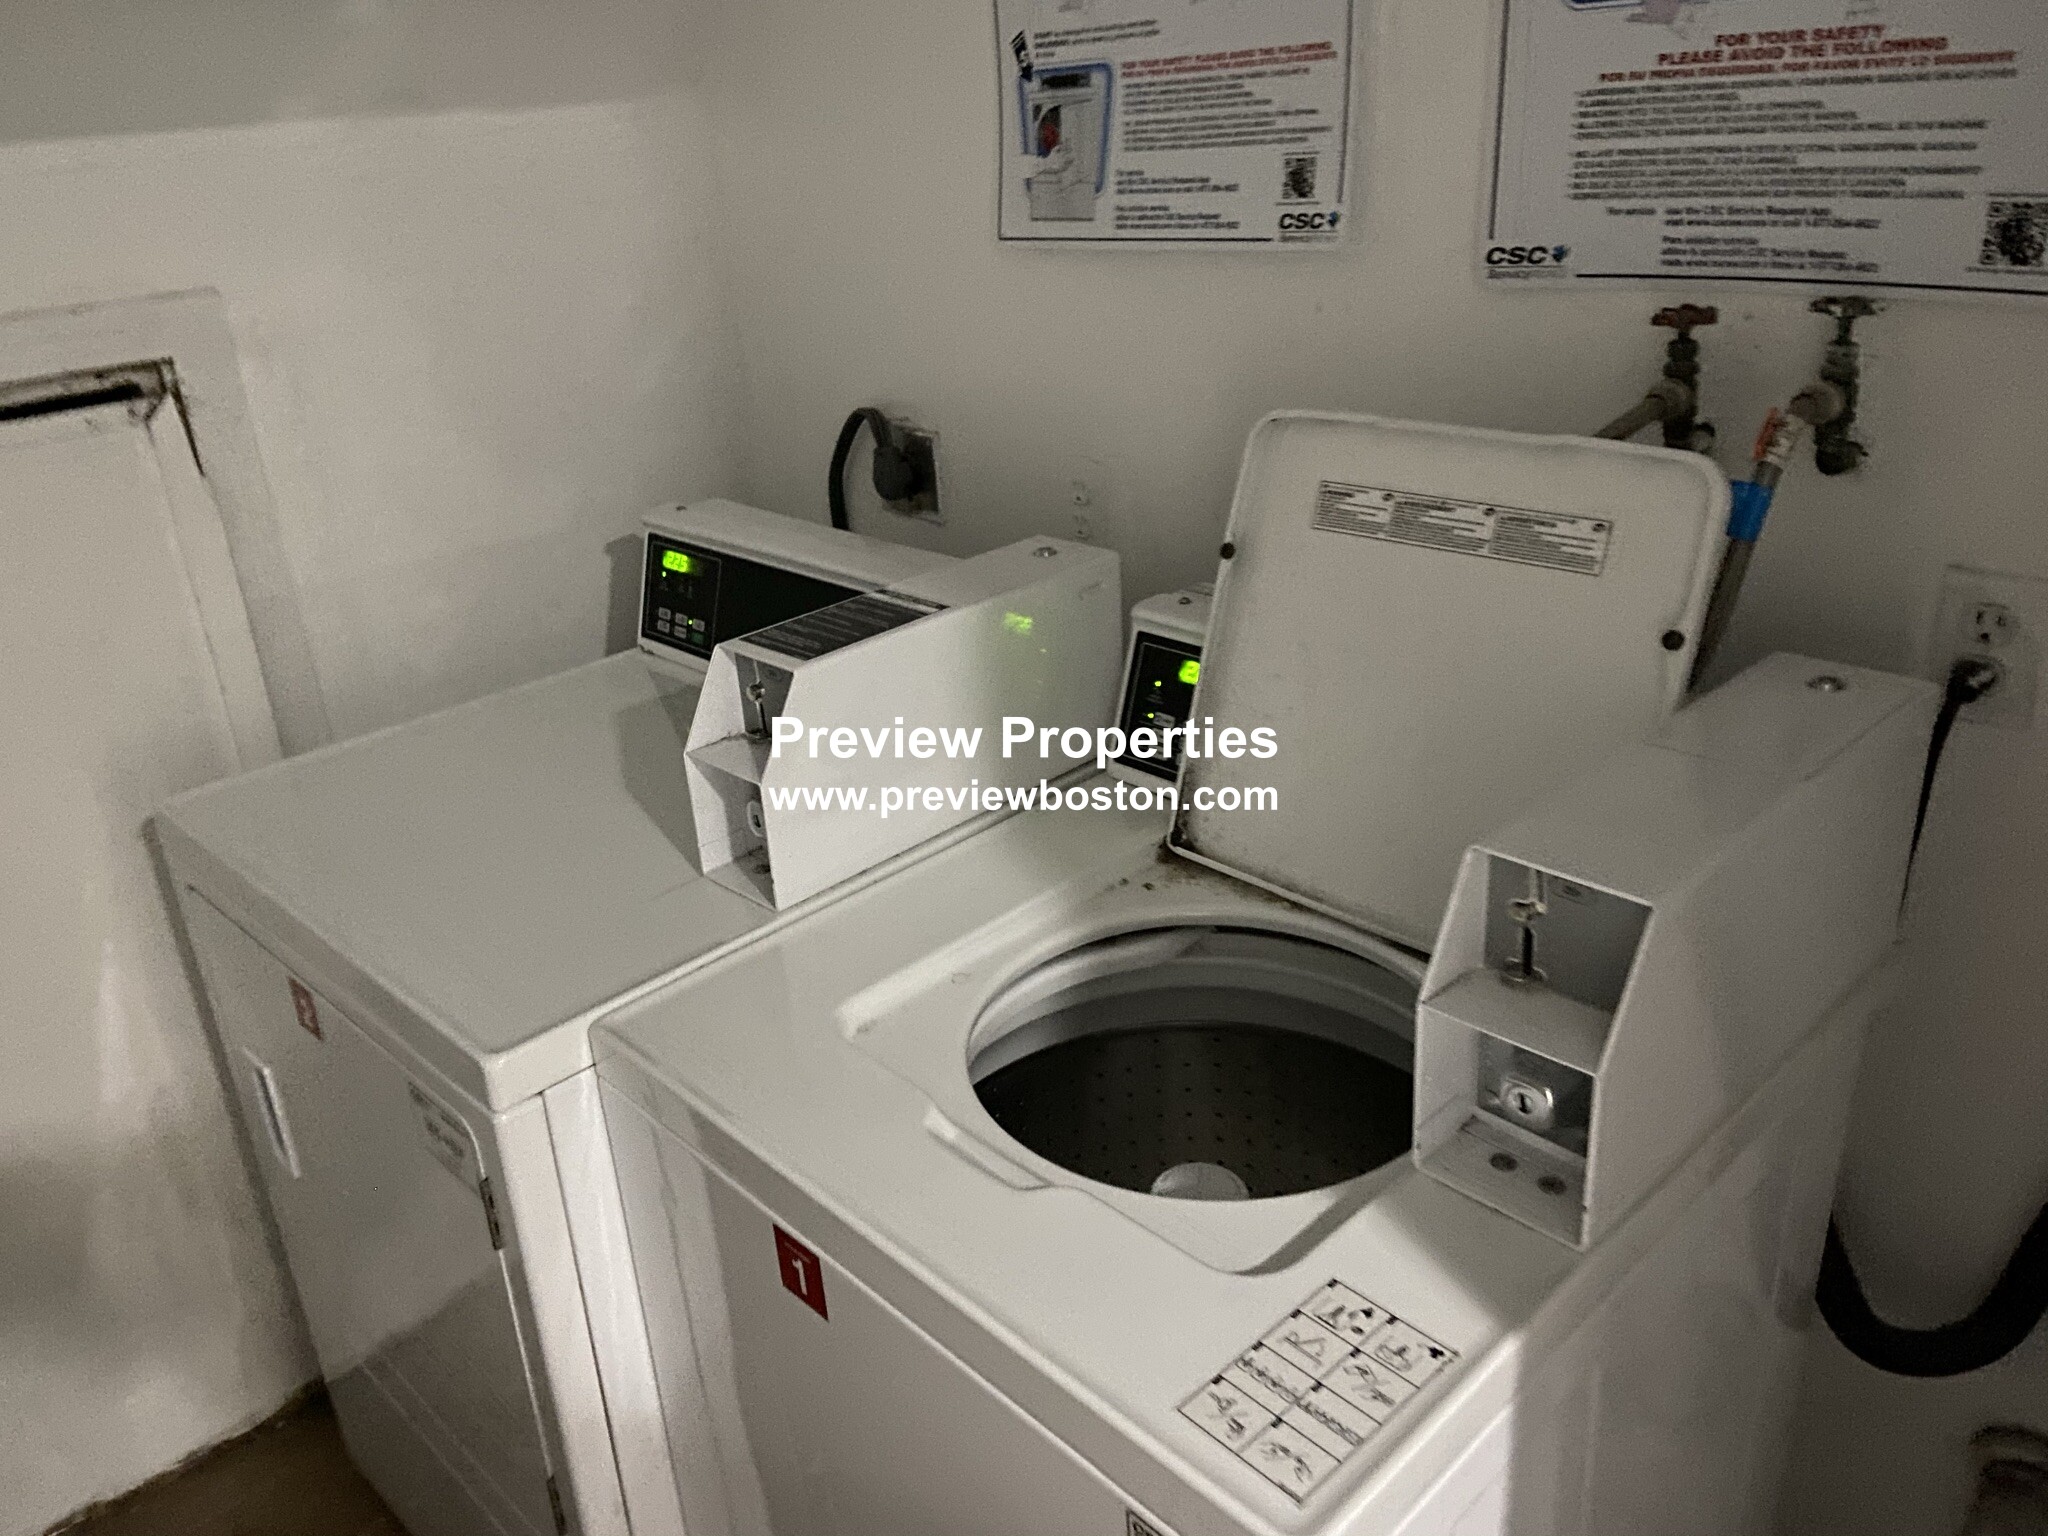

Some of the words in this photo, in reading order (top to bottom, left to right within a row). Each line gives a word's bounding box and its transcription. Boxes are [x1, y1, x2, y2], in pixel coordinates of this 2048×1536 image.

[1715, 33, 1750, 47] FOR
[1757, 29, 1807, 44] YOUR
[1812, 24, 1885, 41] SAFETY
[1658, 49, 1724, 65] PLEASE
[1729, 46, 1785, 60] AVOID
[1791, 43, 1826, 57] THE
[1279, 213, 1325, 230] CSC
[1486, 246, 1549, 265] CSC
[791, 1259, 808, 1296] 1
